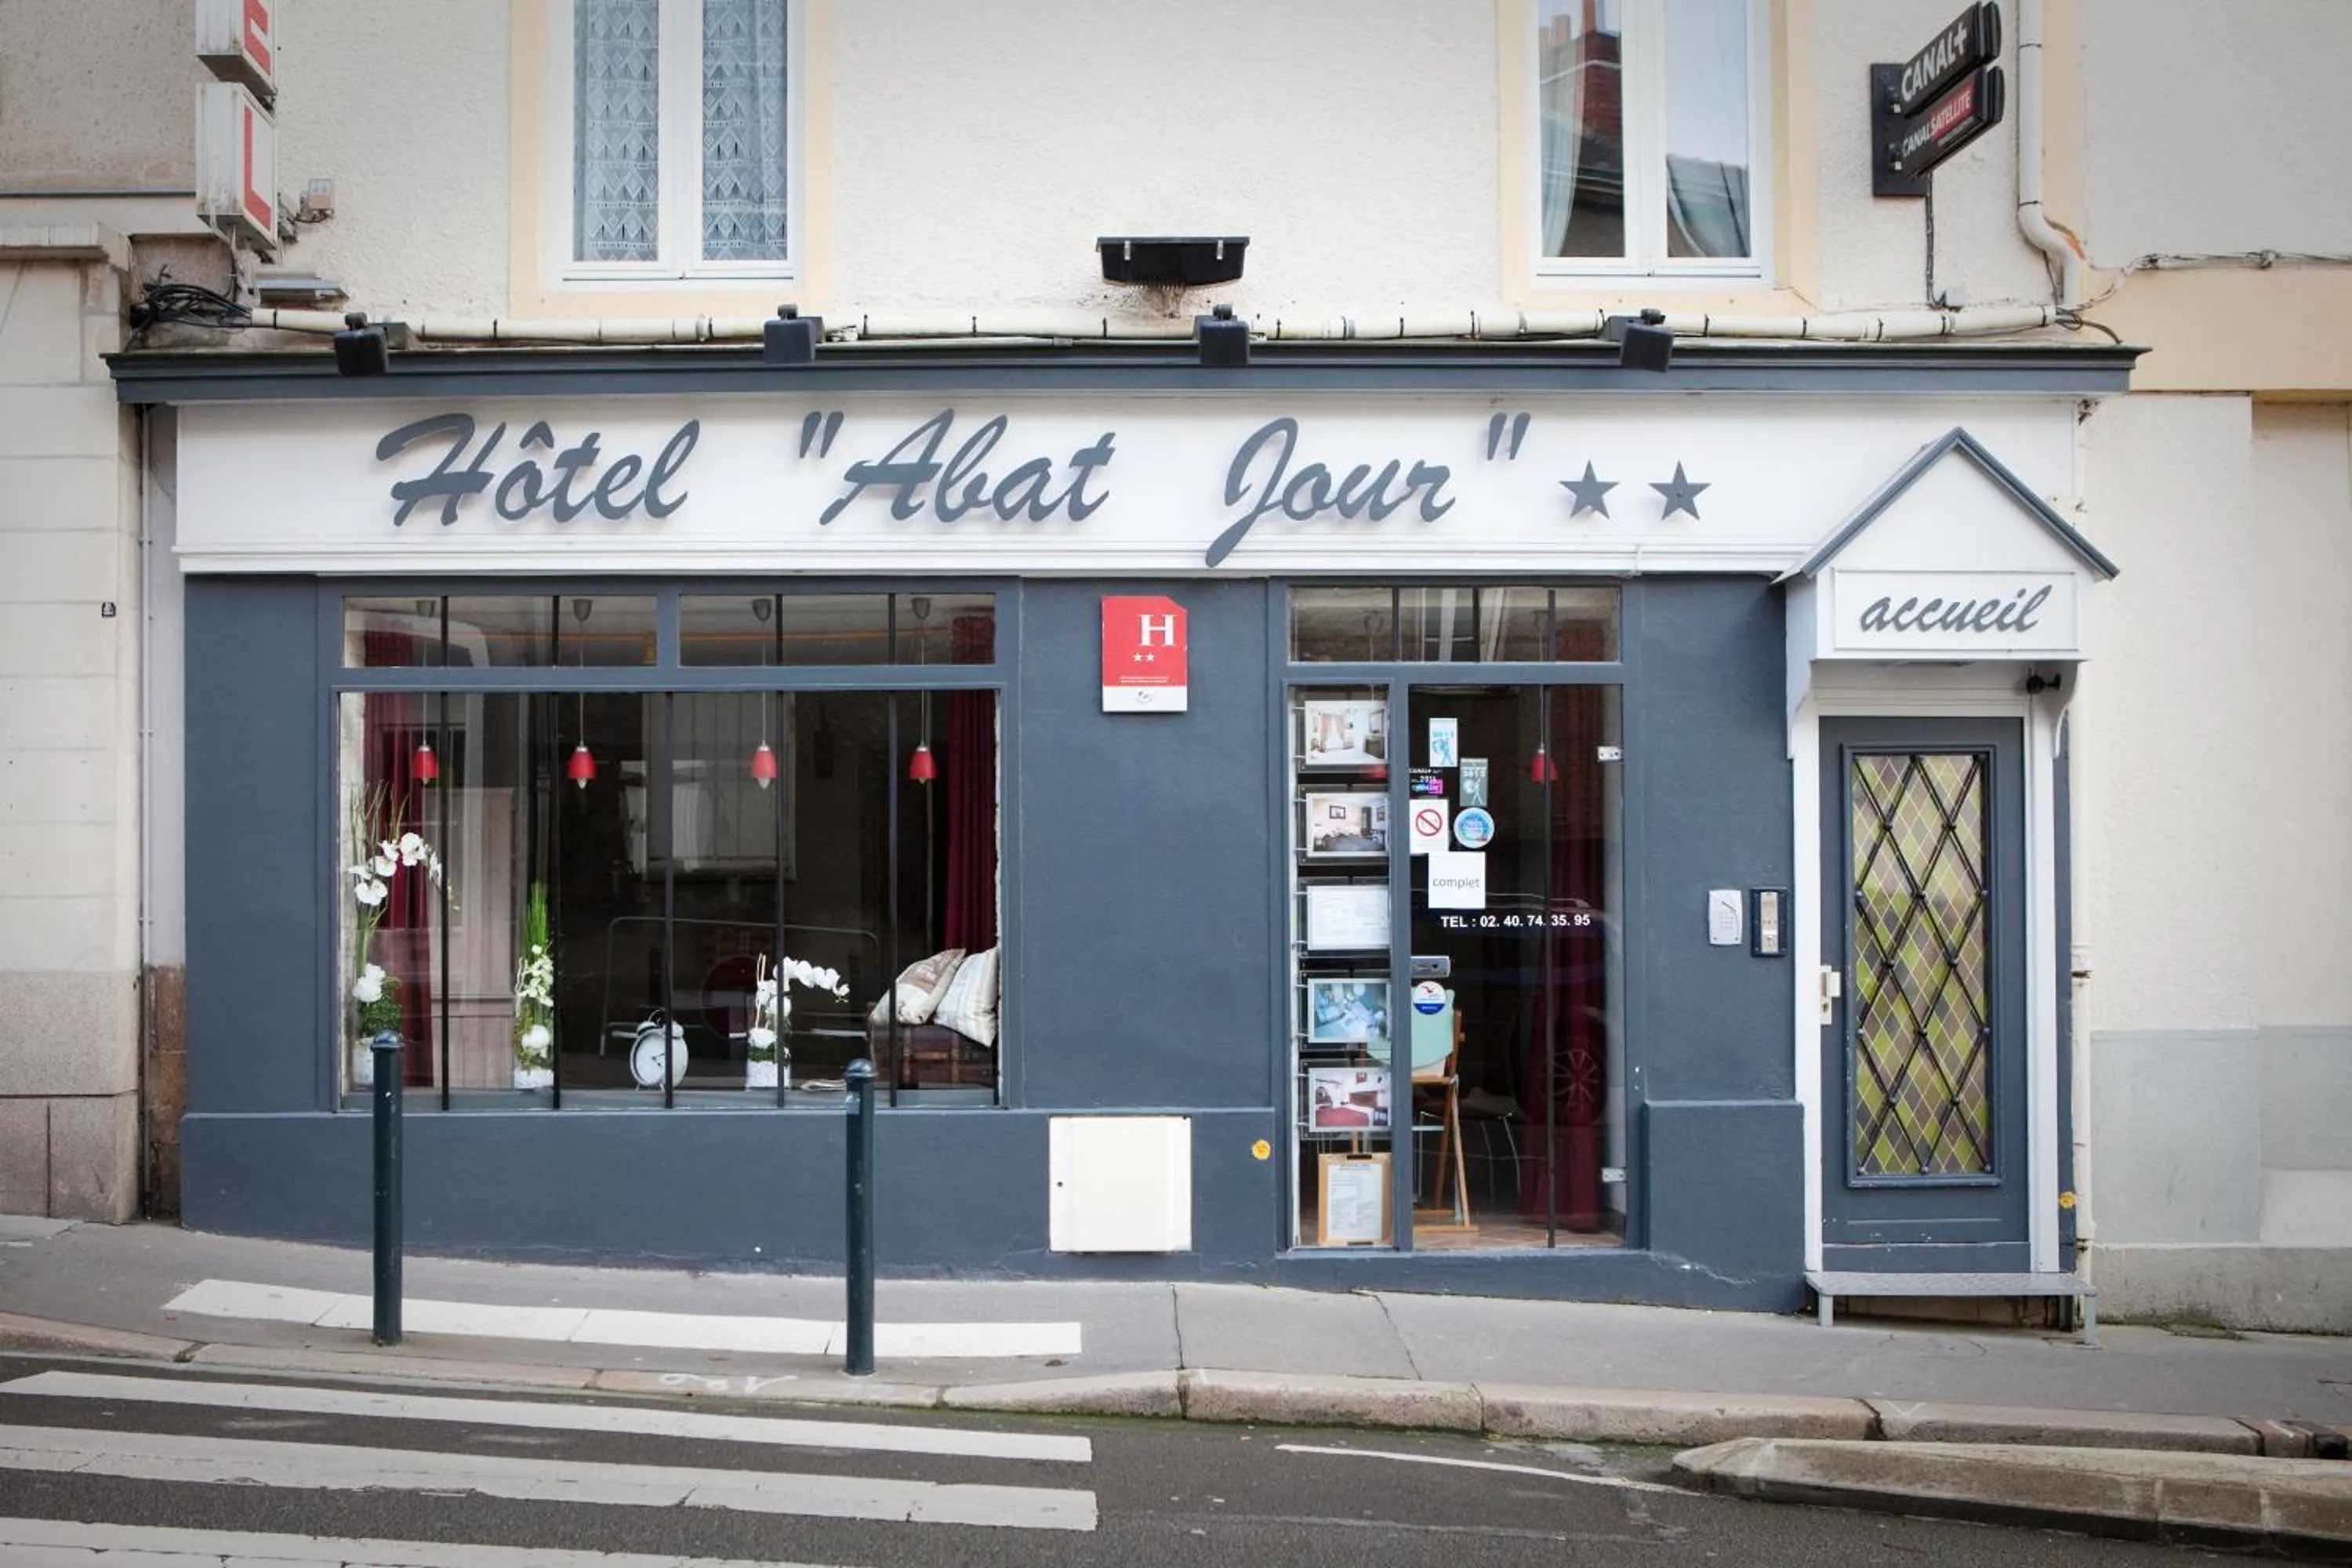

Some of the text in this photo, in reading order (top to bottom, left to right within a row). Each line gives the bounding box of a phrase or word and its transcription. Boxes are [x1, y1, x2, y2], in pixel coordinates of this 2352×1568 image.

[1901, 21, 1967, 102] CANAL+
[376, 408, 1531, 568] Hôtel "Abat Jour"
[1860, 584, 2053, 633] accueil
[1138, 614, 1177, 647] H
[1432, 877, 1480, 888] complet
[1440, 916, 1468, 927] TEL
[1573, 914, 1591, 926] 95
